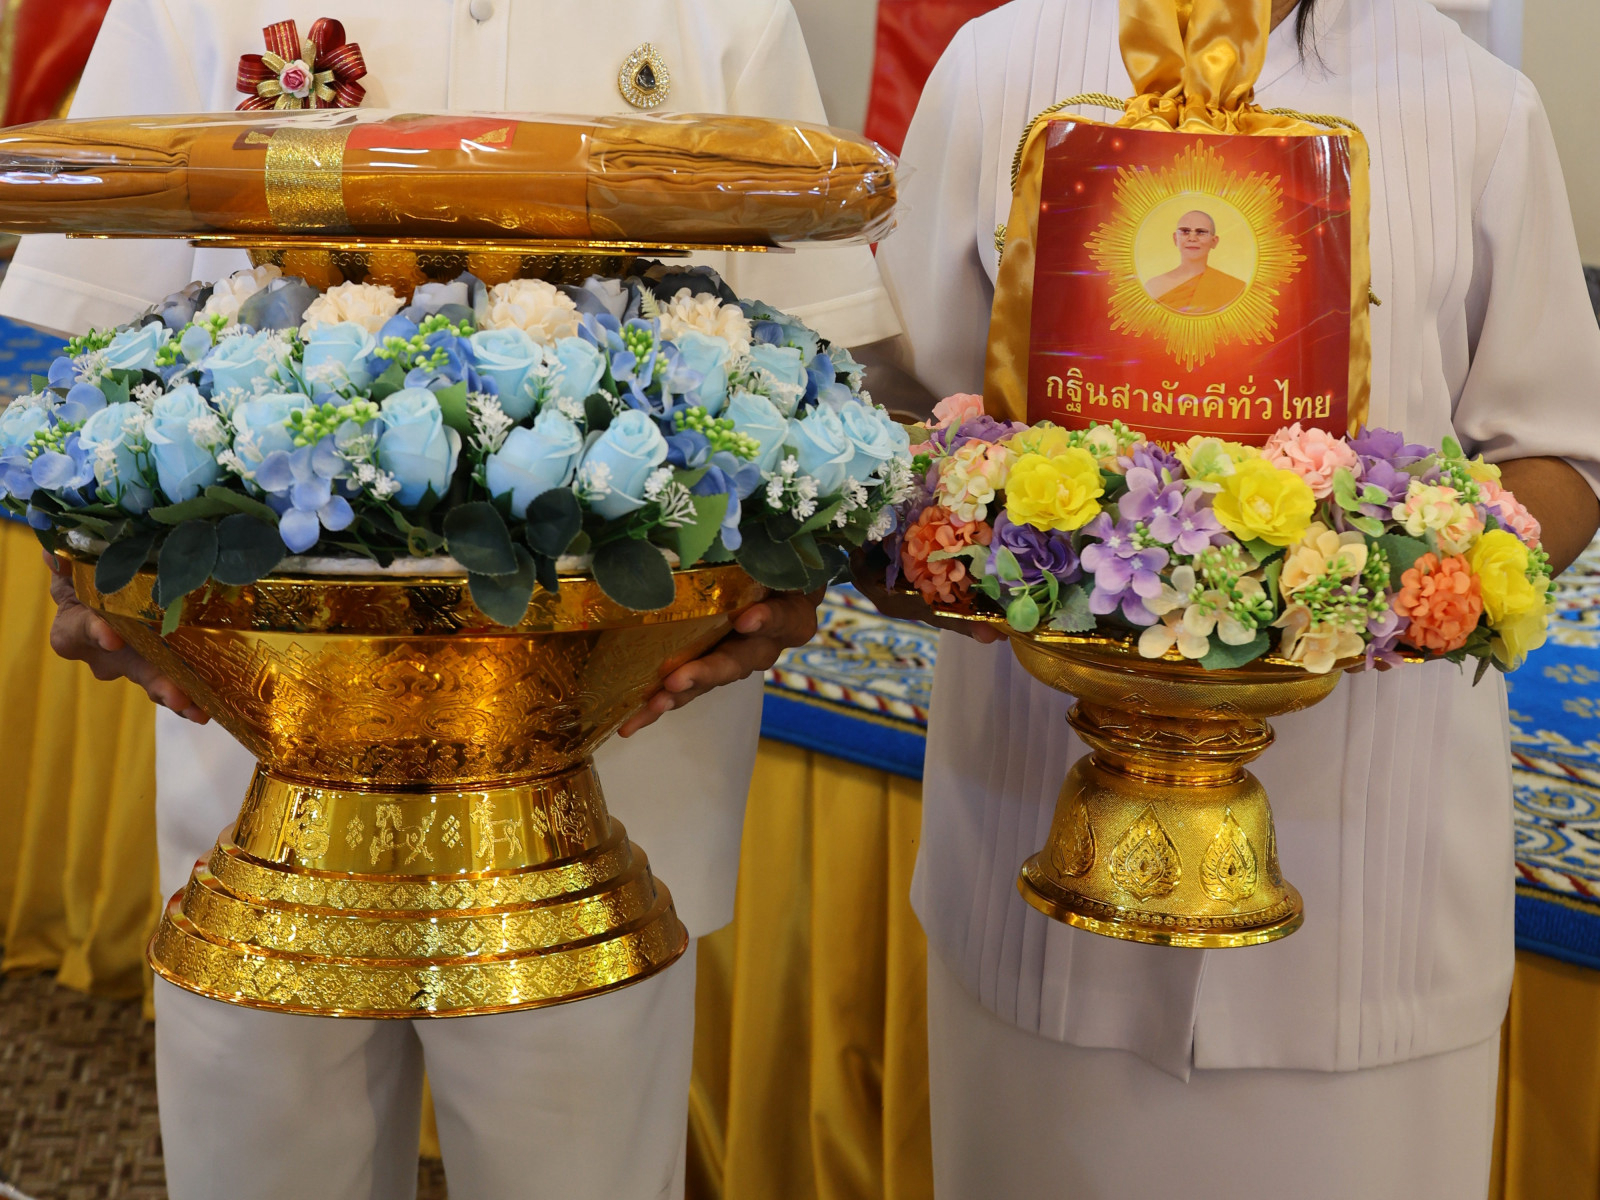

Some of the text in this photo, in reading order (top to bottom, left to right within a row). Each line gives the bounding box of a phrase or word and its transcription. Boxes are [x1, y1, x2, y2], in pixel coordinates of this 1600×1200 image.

[1046, 367, 1331, 420] กฐินสามัคคีทั่วไทย
